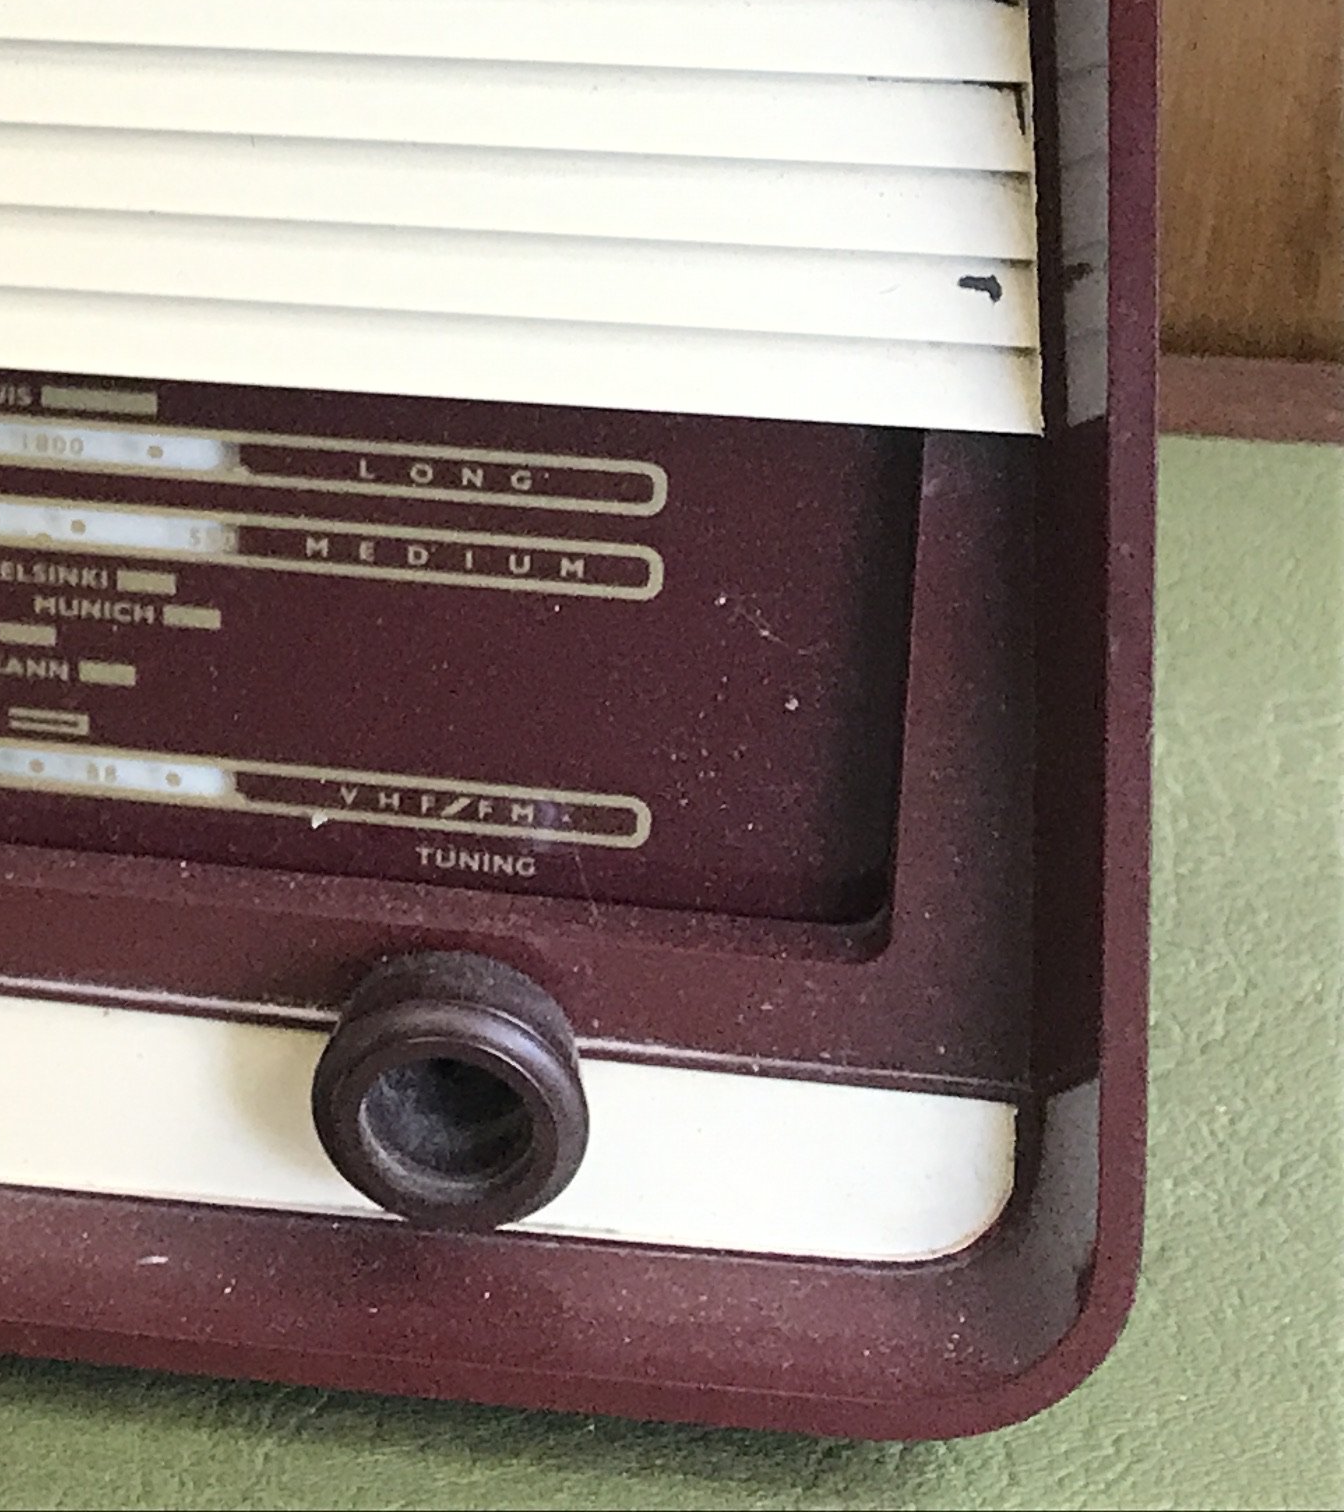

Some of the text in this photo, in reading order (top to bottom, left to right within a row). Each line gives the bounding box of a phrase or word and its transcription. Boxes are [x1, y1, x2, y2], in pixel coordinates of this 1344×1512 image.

[21, 433, 84, 456] 1800
[359, 458, 533, 491] LONG
[307, 537, 586, 579] MEDIUM
[33, 594, 155, 624] MUNICH
[340, 786, 535, 824] VHF/FM
[415, 846, 537, 877] TUNING
